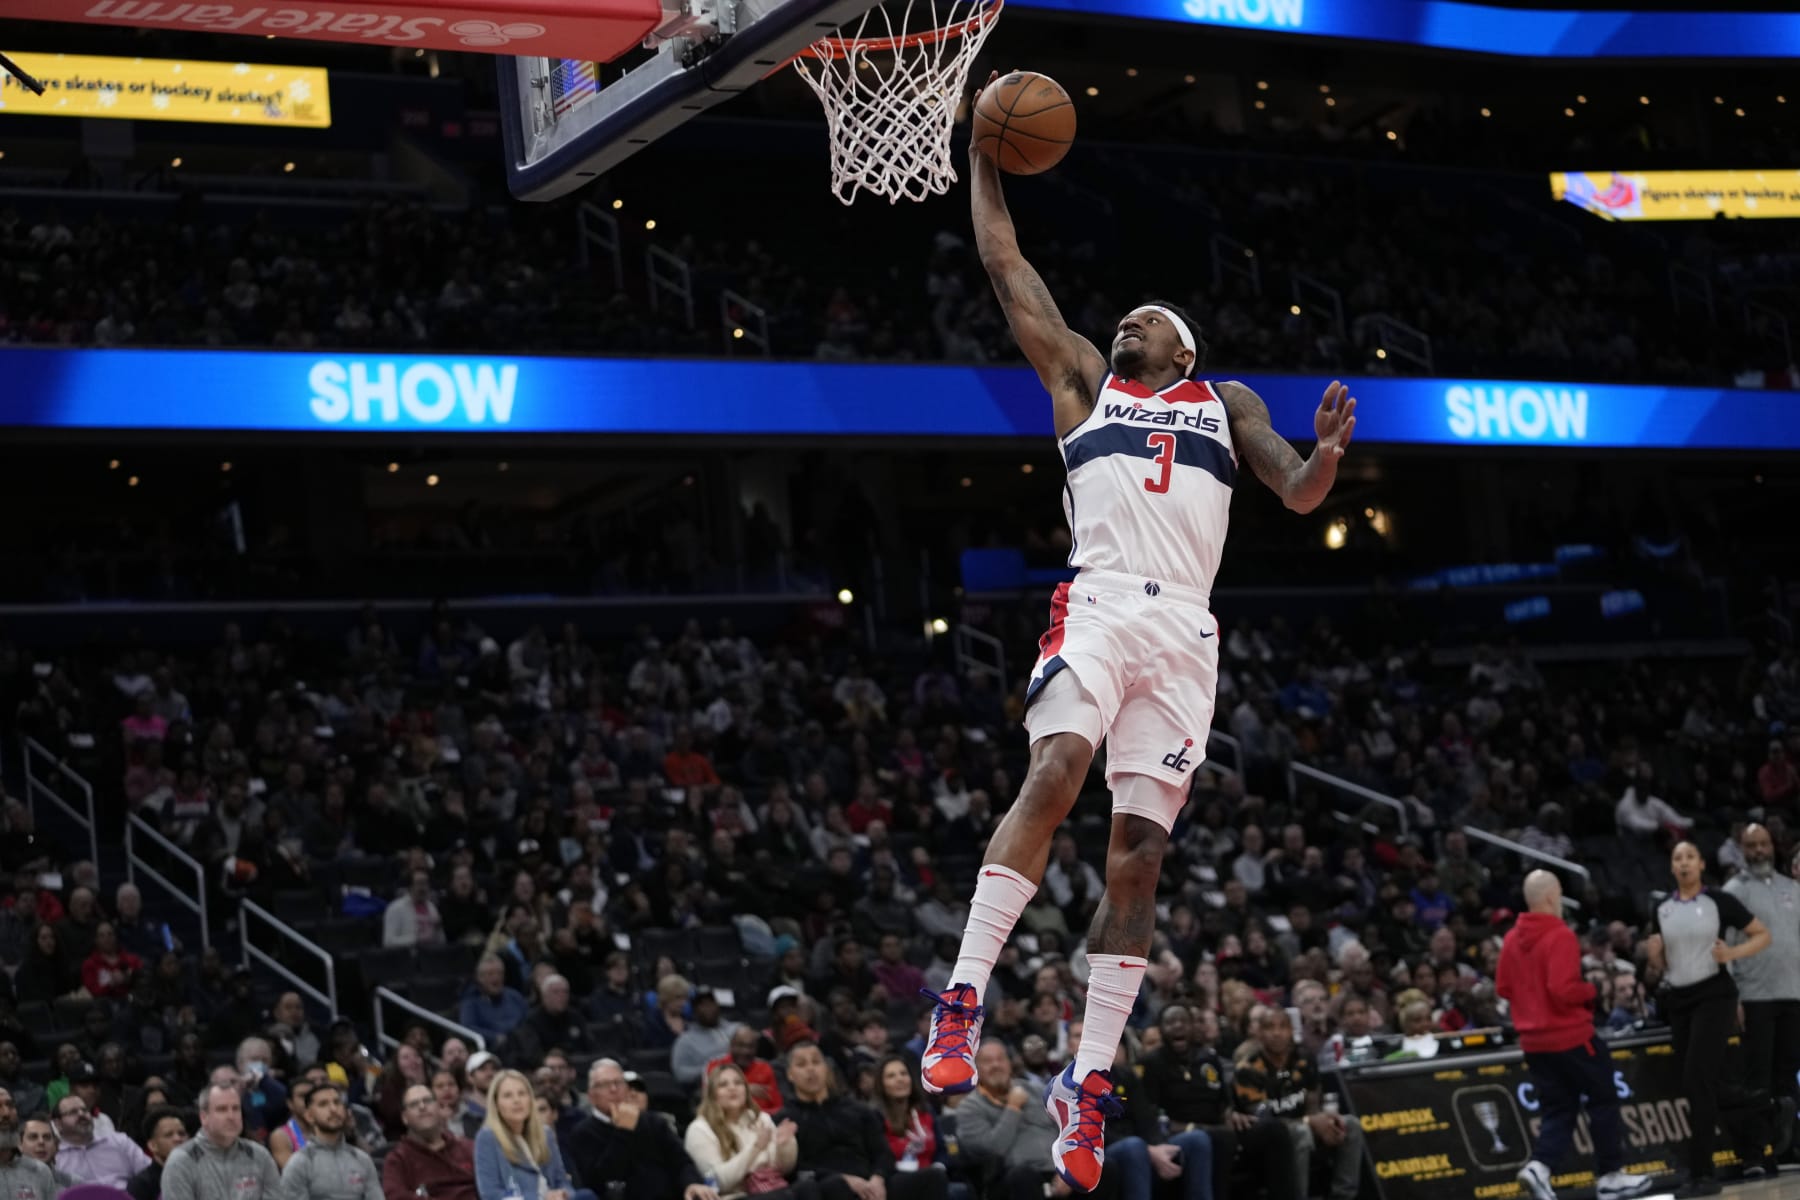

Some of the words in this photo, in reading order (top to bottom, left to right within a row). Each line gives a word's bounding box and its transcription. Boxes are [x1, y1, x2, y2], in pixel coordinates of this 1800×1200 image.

[66, 75, 123, 92] skates
[129, 80, 147, 93] or
[150, 76, 212, 100] hockey
[308, 360, 519, 423] SHOW
[1445, 385, 1589, 439] SHOW
[1144, 432, 1176, 494] 3
